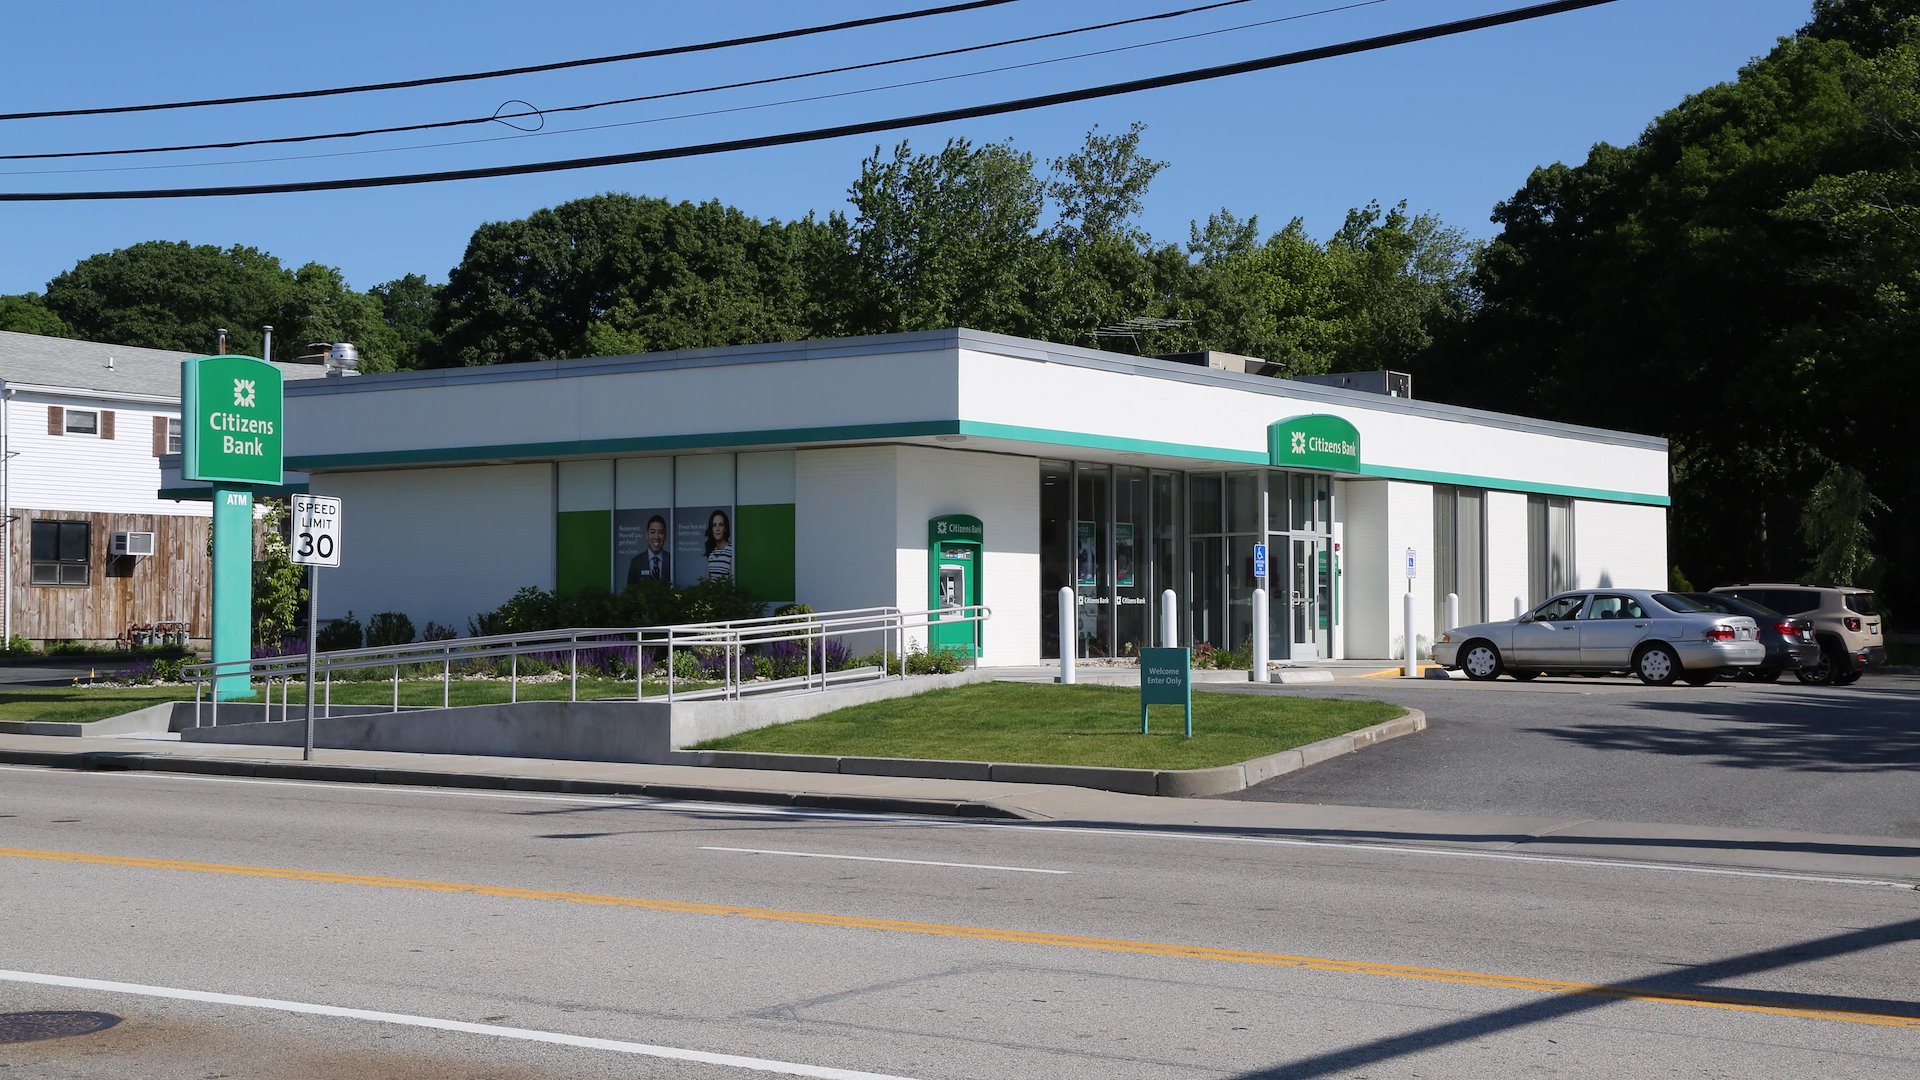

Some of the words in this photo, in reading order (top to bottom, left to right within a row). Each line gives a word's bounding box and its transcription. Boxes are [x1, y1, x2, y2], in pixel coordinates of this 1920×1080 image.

[209, 411, 274, 435] Citizens
[223, 435, 263, 456] Bank
[1308, 436, 1341, 454] Citizens
[1341, 440, 1356, 456] Bank
[226, 493, 247, 506] ATM
[297, 502, 336, 515] SPEED
[301, 517, 333, 529] LIMIT
[948, 523, 972, 534] Citizens
[971, 524, 982, 534] Bank
[297, 532, 334, 559] 30
[1083, 596, 1100, 604] Citizens
[1121, 596, 1137, 605] Citizens
[1136, 597, 1146, 605] Bank
[1149, 667, 1180, 675] Welcome
[1166, 677, 1182, 686] Only
